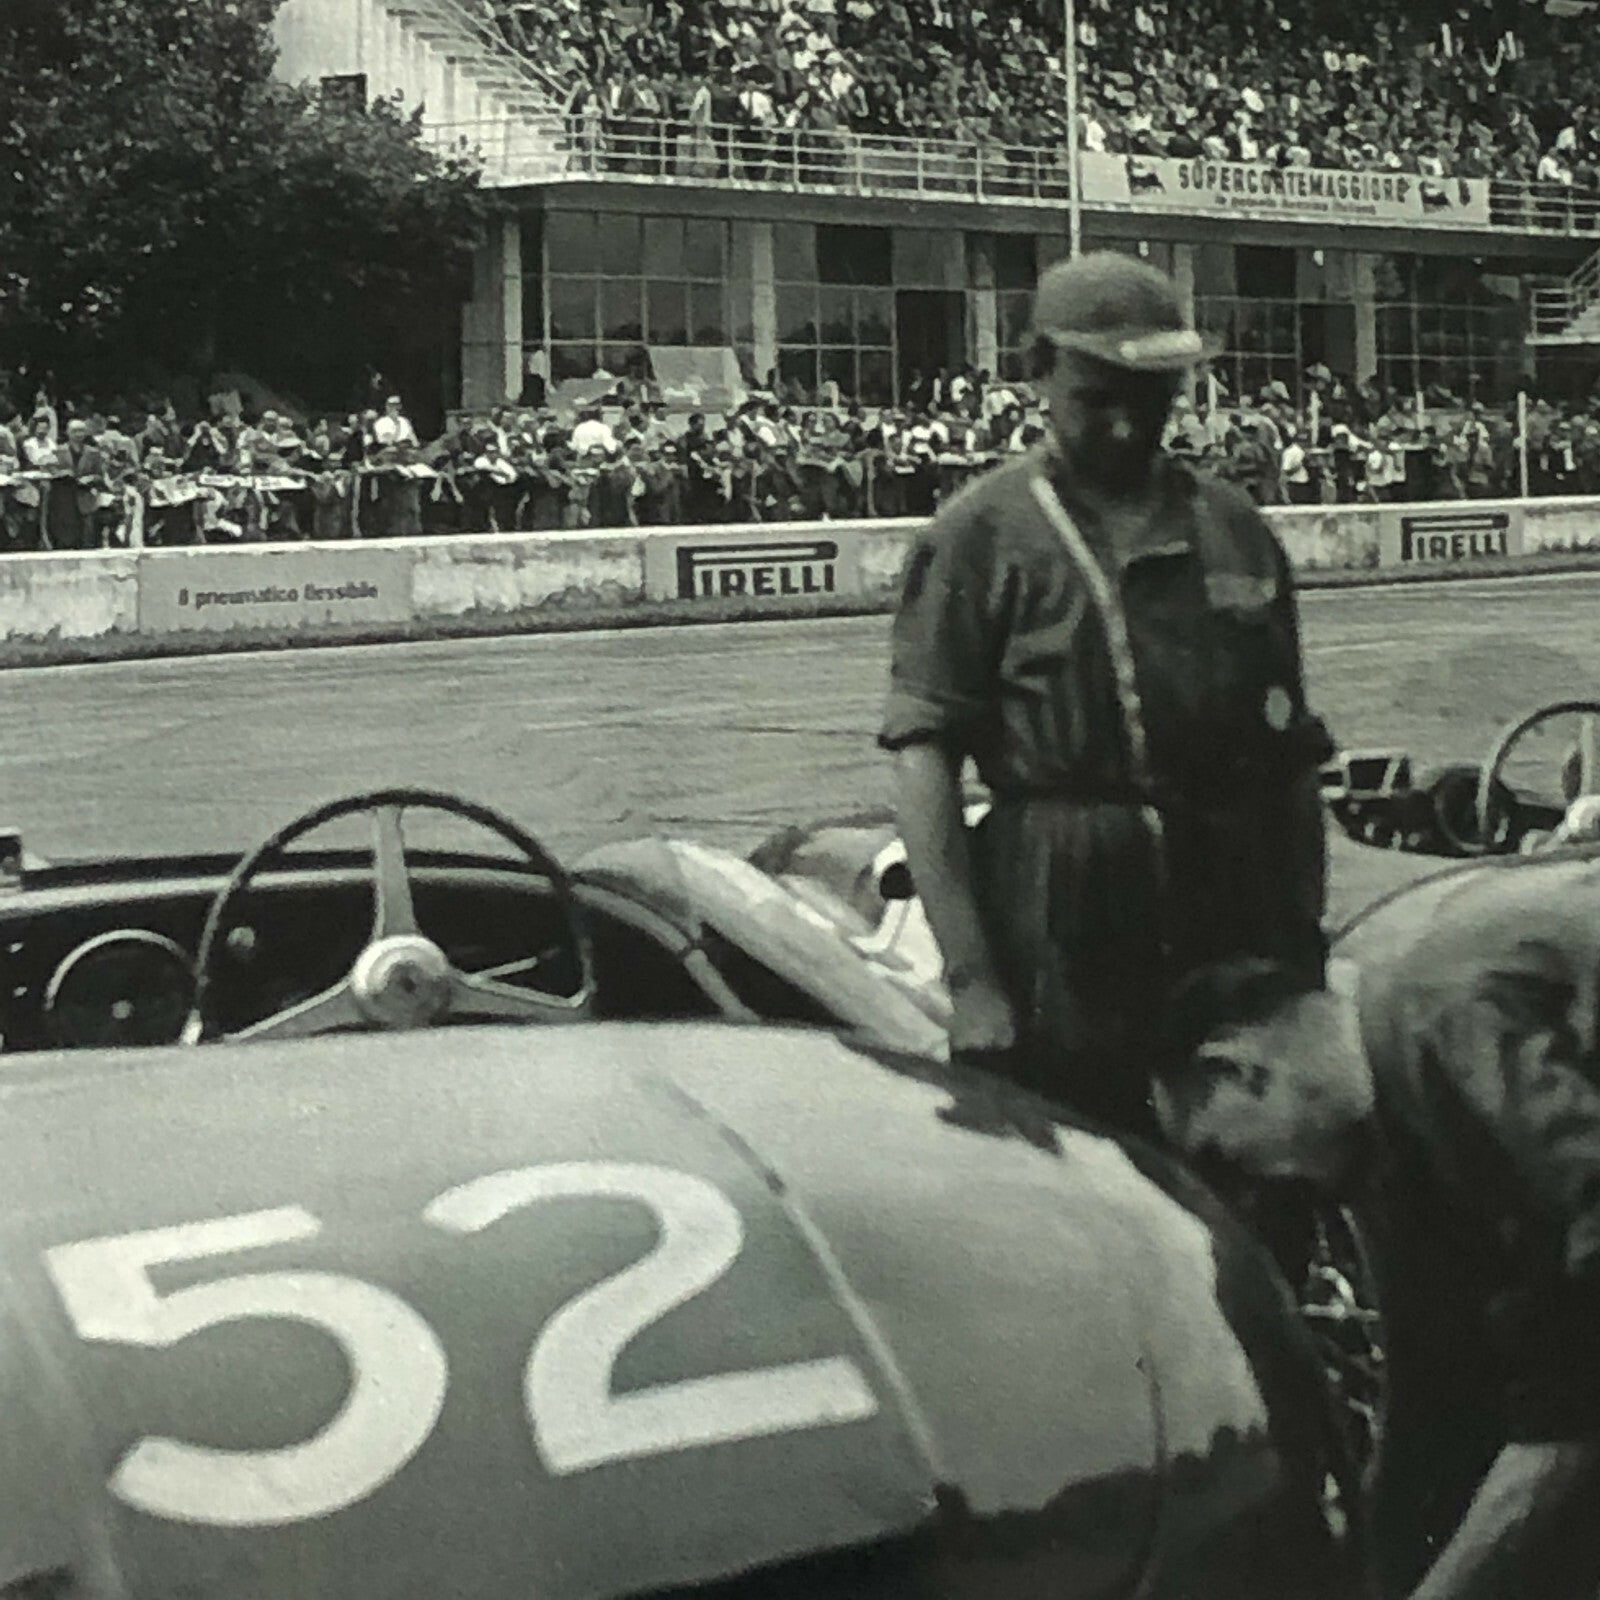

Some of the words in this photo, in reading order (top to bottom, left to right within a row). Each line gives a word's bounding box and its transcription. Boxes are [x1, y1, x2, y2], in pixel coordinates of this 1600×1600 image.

[1401, 512, 1510, 561] PIRELLI
[676, 541, 838, 599] PIRELLI
[43, 1160, 879, 1528] 52
